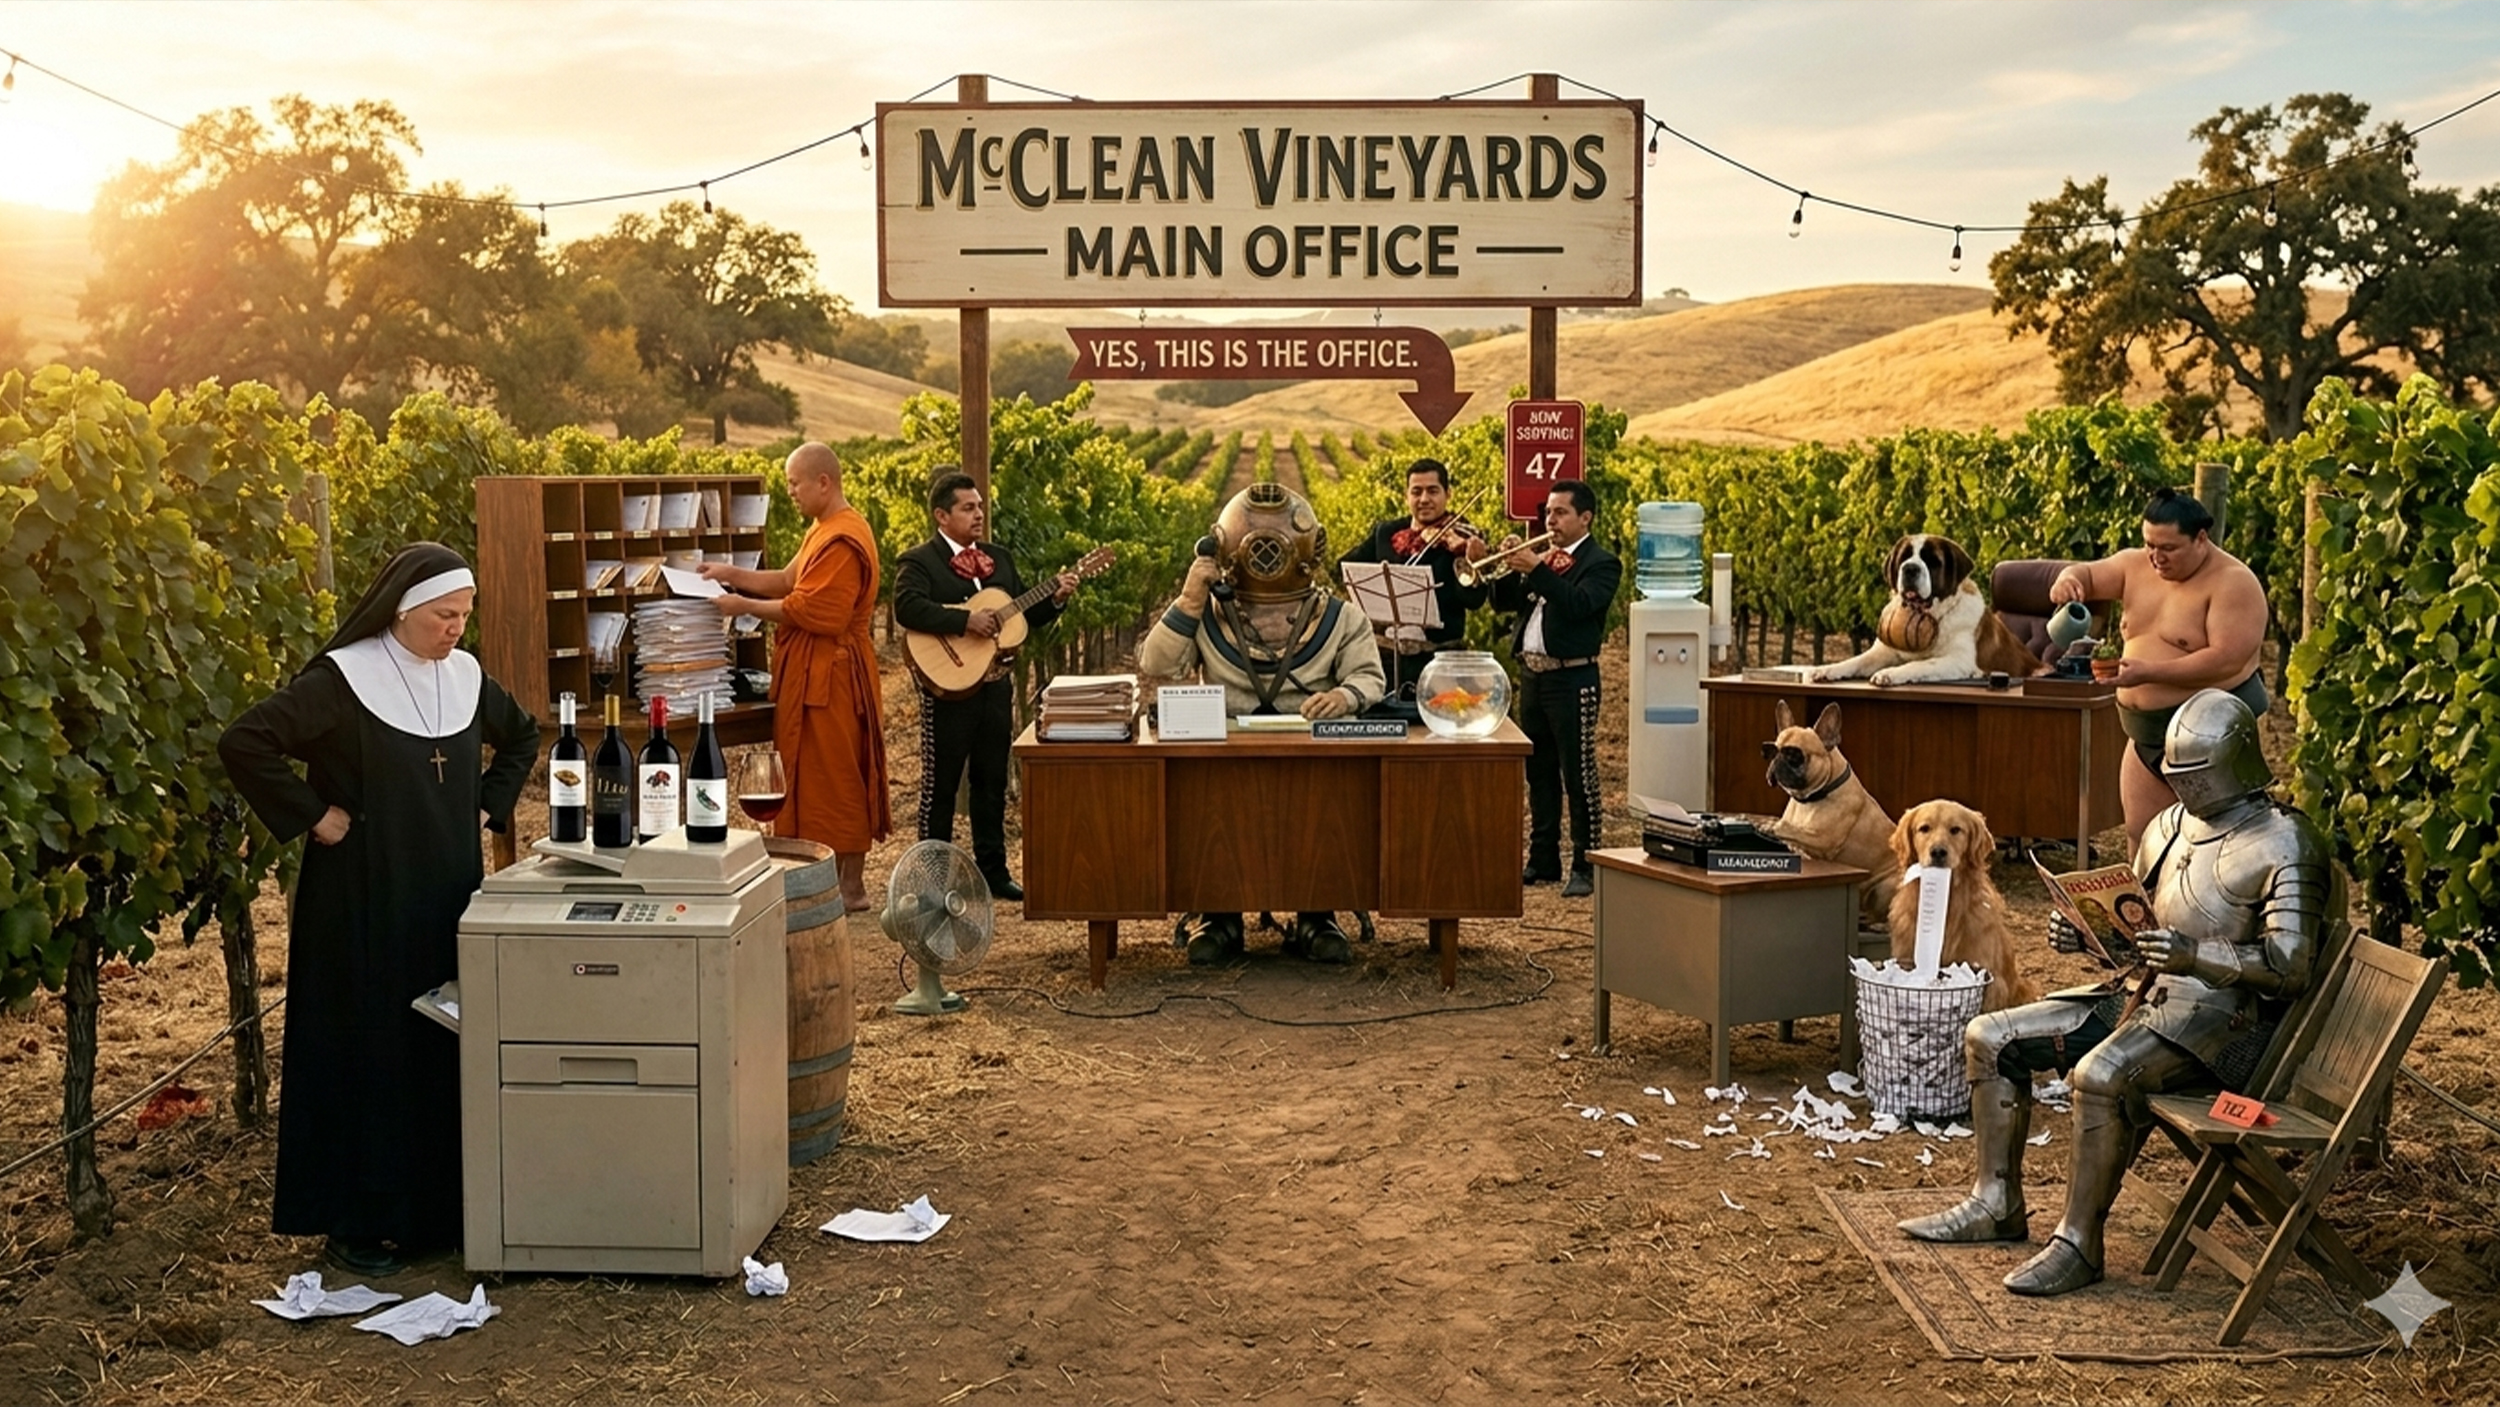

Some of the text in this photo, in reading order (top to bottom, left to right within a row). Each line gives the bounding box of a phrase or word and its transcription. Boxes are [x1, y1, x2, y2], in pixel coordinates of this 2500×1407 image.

[1240, 126, 1608, 208] VINEYARDS
[1066, 223, 1461, 279] MAIN OFFICE
[1089, 339, 1419, 373] YES, THIS IS THE OFFICE.
[1525, 452, 1566, 481] 47
